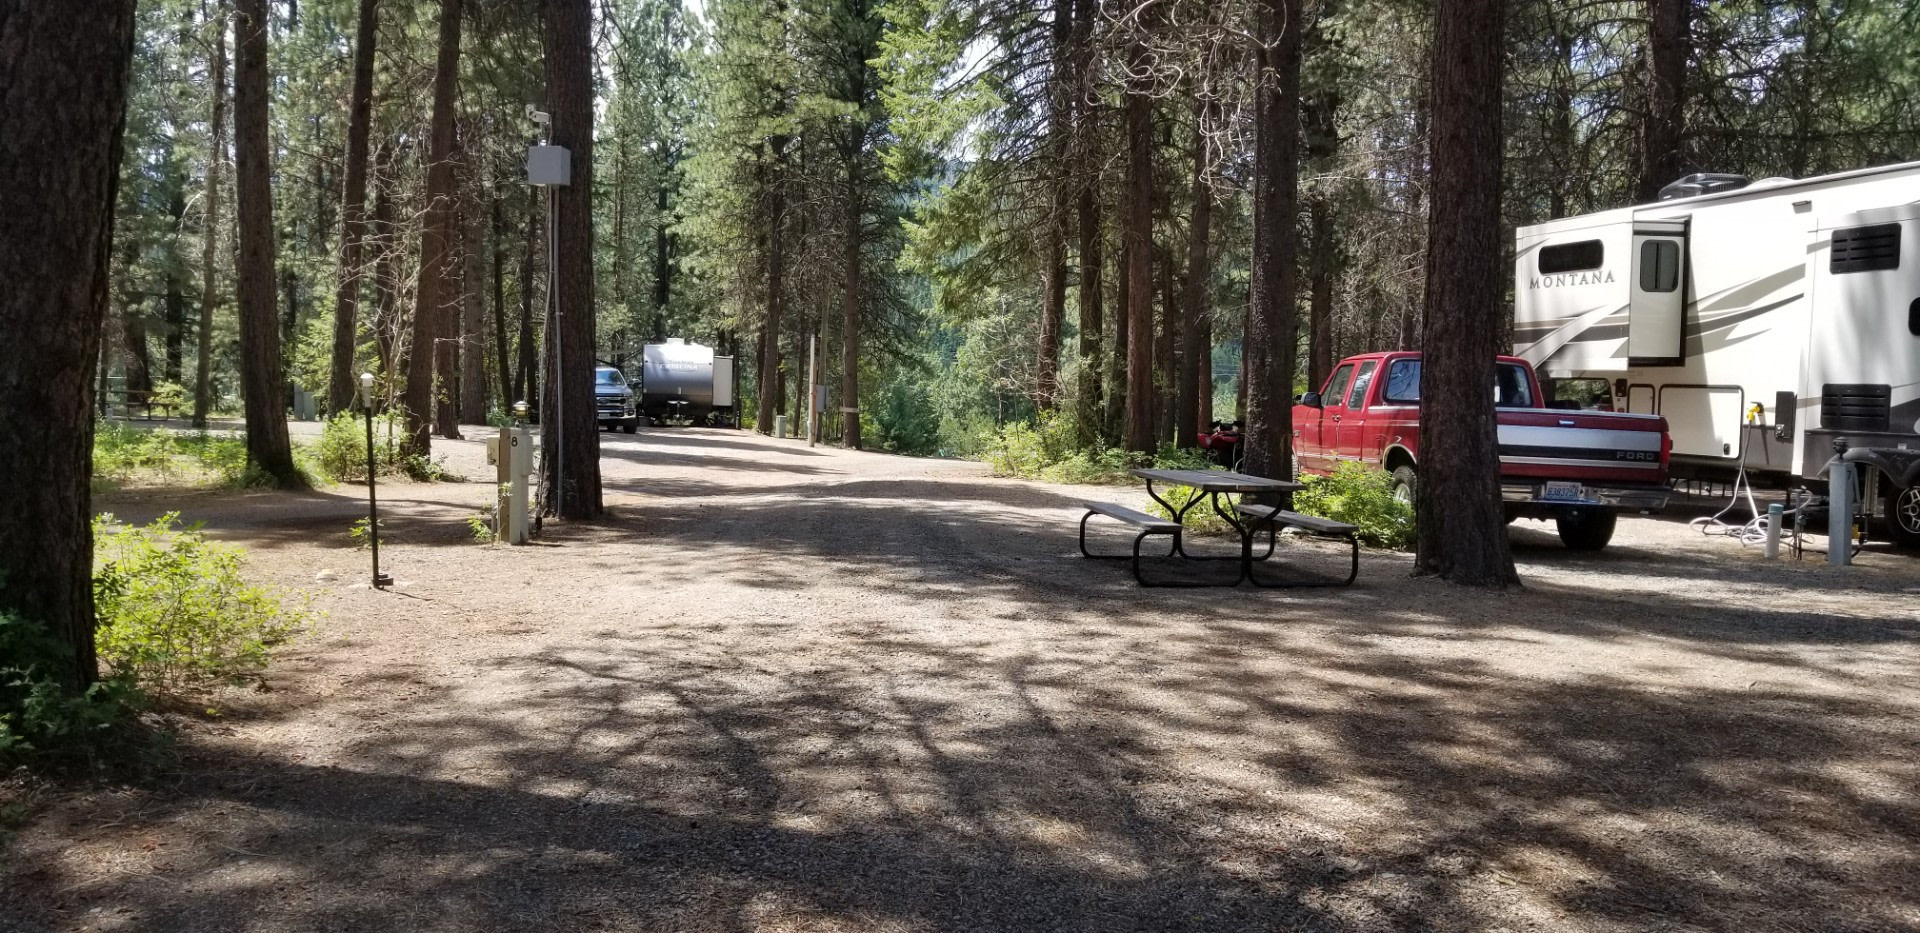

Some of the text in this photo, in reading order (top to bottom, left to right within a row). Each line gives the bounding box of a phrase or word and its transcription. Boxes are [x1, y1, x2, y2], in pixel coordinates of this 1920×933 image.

[1529, 270, 1615, 289] MONTANA
[511, 436, 518, 447] 8
[1616, 451, 1655, 460] FORD
[1846, 470, 1852, 480] 7
